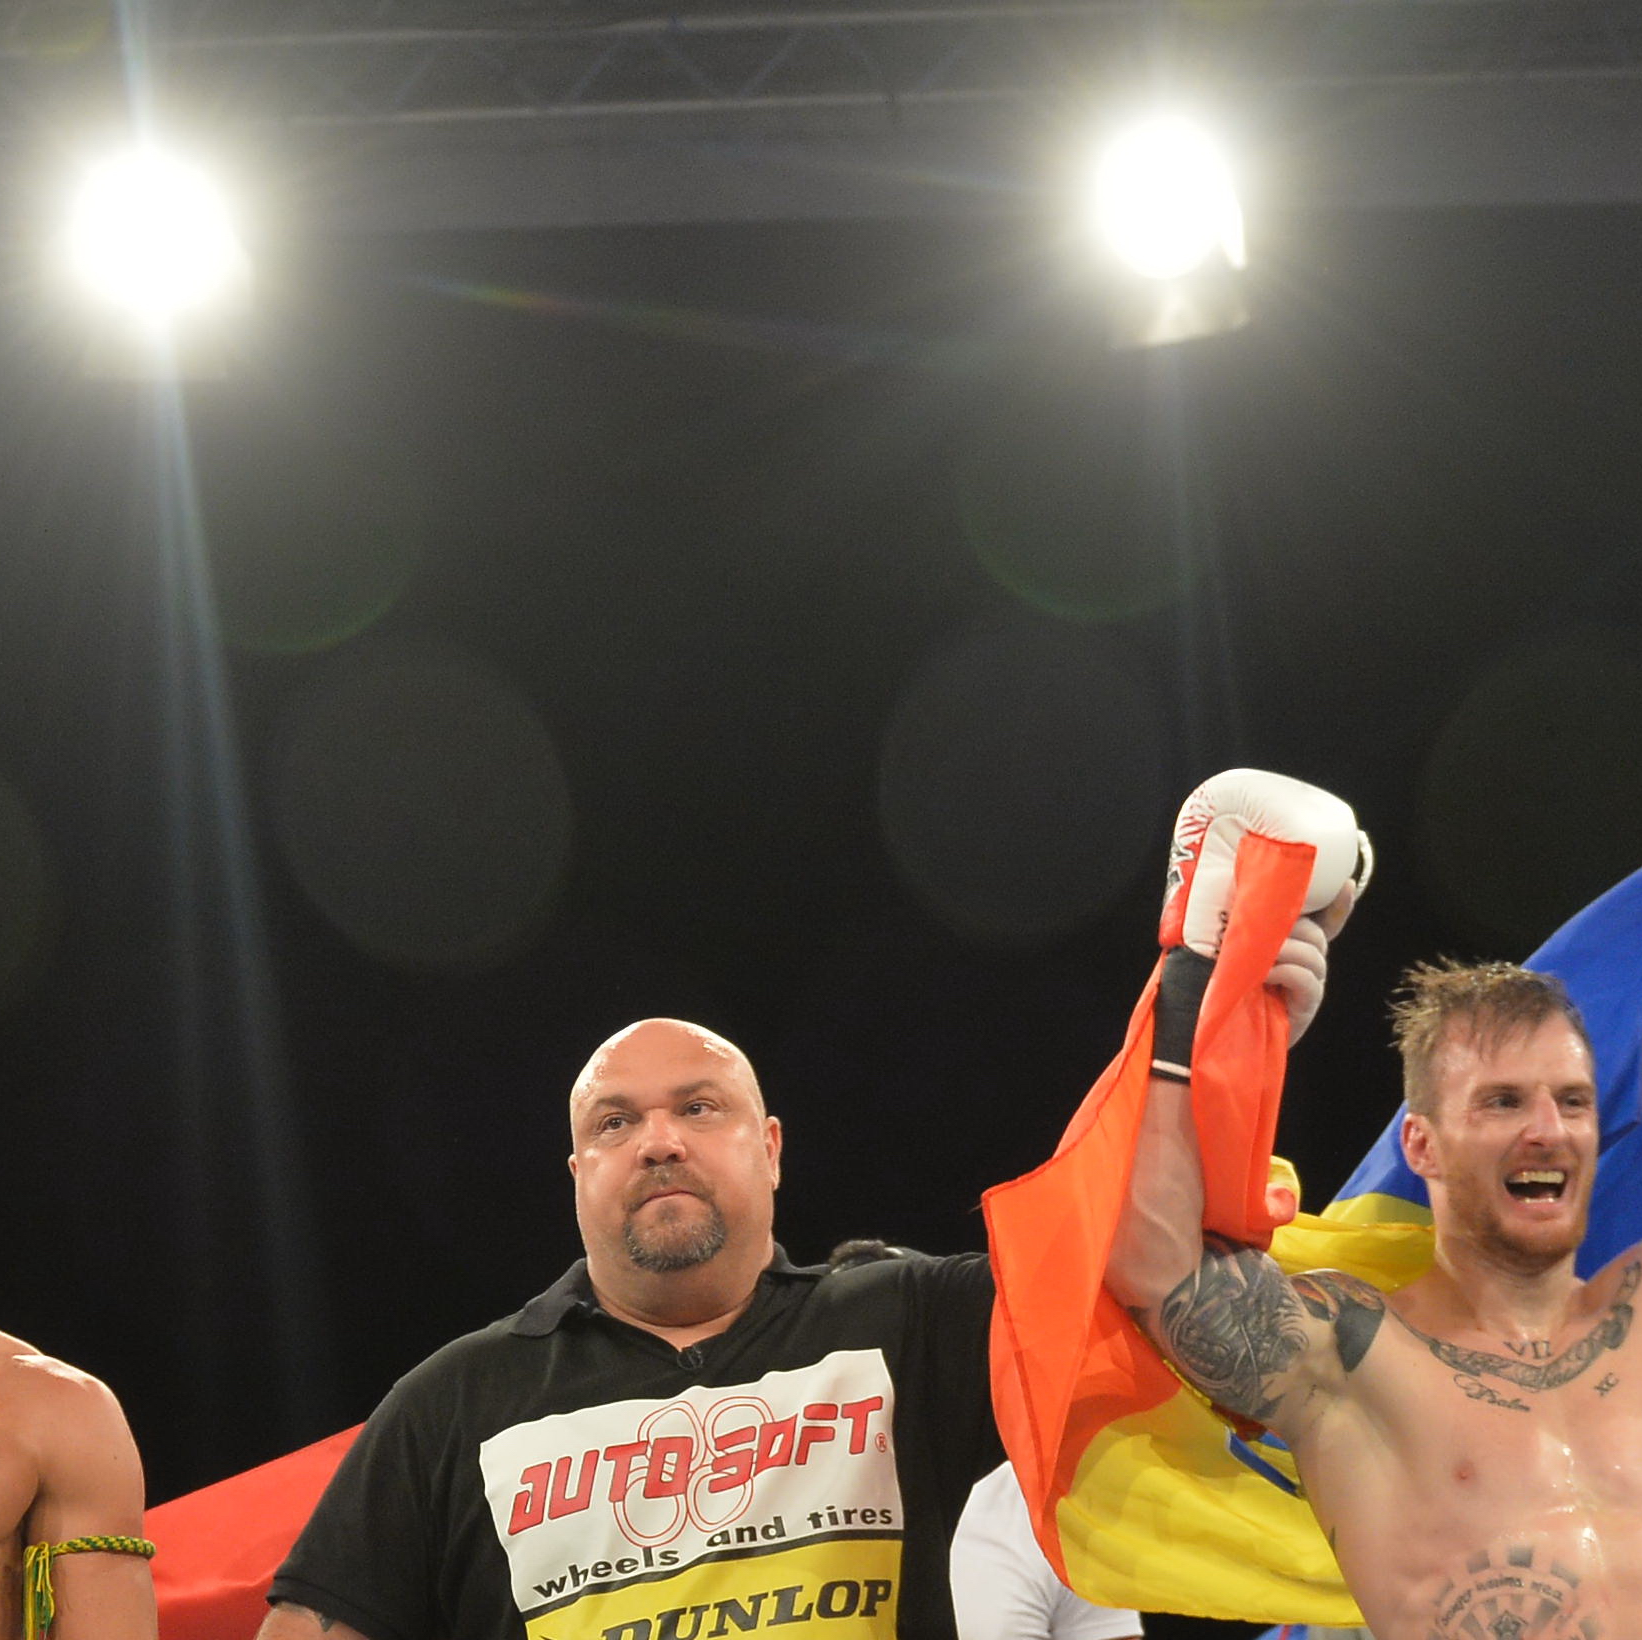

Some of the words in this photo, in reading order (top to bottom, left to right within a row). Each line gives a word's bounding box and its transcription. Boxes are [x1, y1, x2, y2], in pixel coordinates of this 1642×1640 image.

[508, 1438, 693, 1536] AUTO
[533, 1545, 679, 1600] wheels
[706, 1516, 784, 1550] and
[808, 1504, 893, 1531] tires
